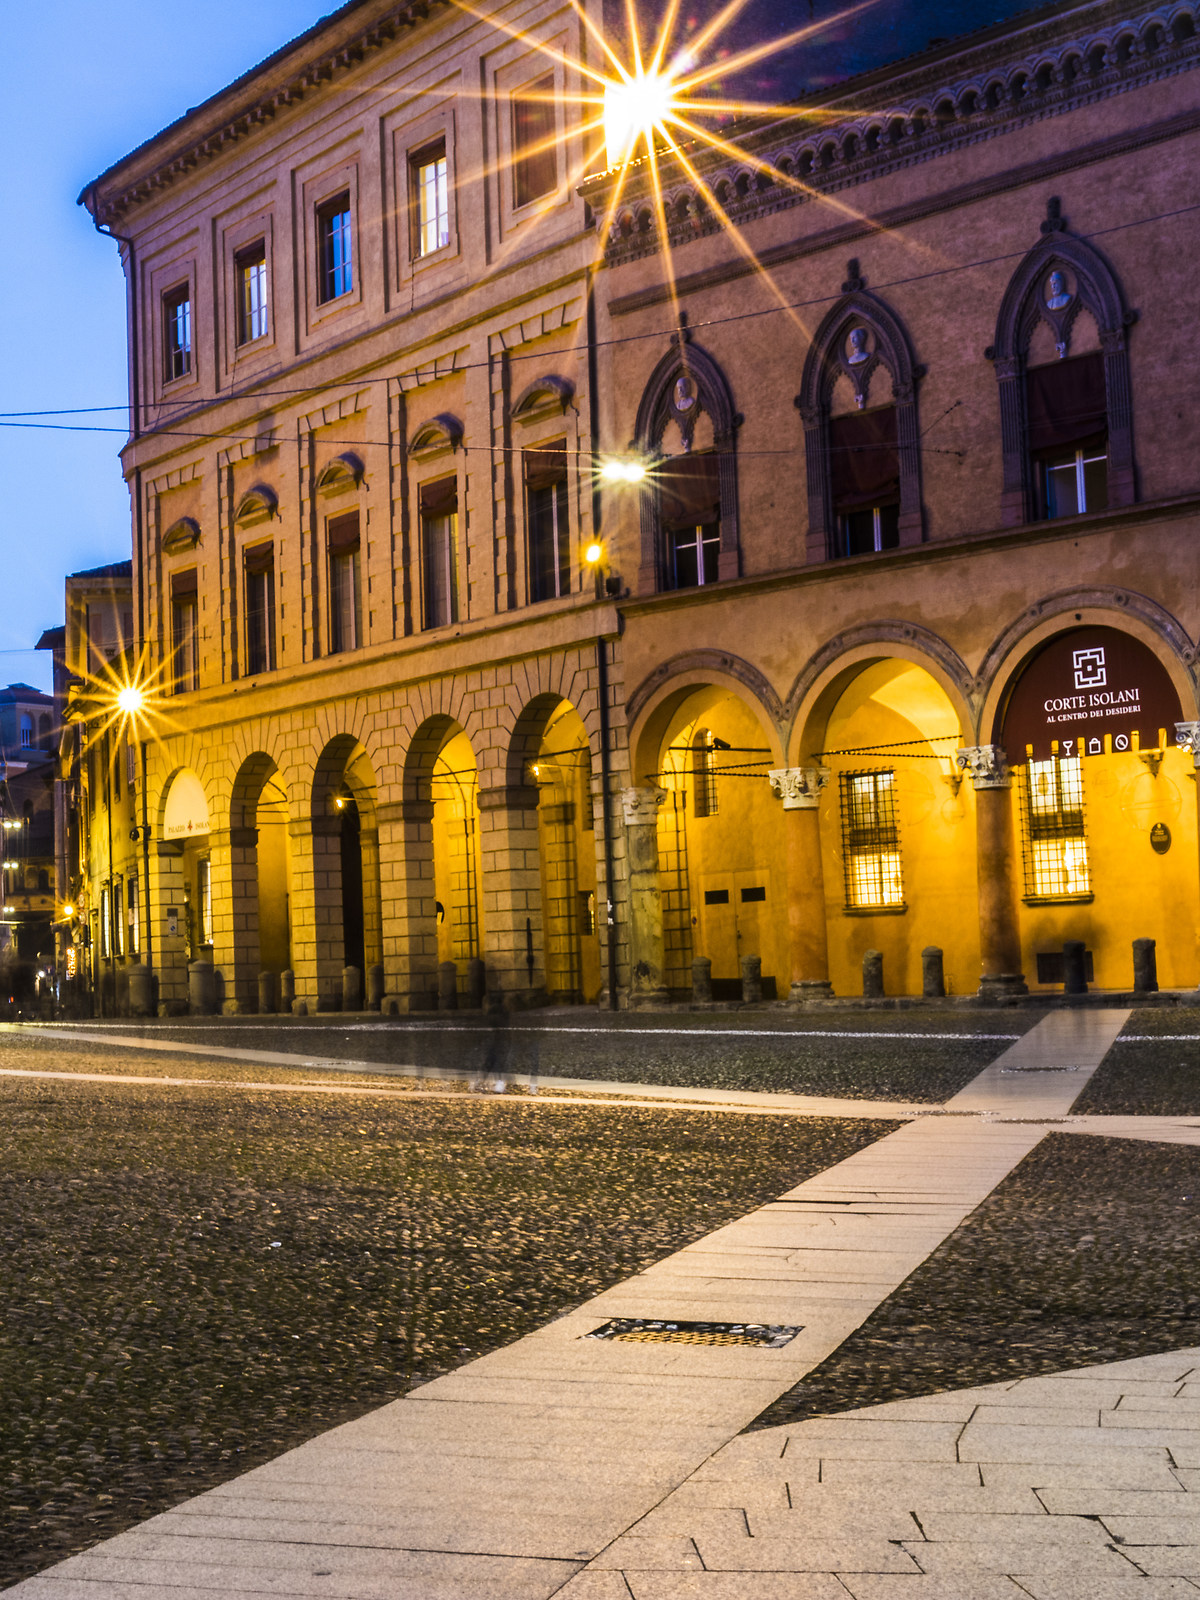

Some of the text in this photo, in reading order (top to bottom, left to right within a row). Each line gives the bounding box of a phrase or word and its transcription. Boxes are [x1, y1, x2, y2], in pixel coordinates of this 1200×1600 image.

[1044, 688, 1140, 712] CORTE ISOLANI
[1046, 705, 1141, 723] AL CENTRO DEI DESIDERI
[168, 821, 210, 834] PALAZZO ISOLAN
